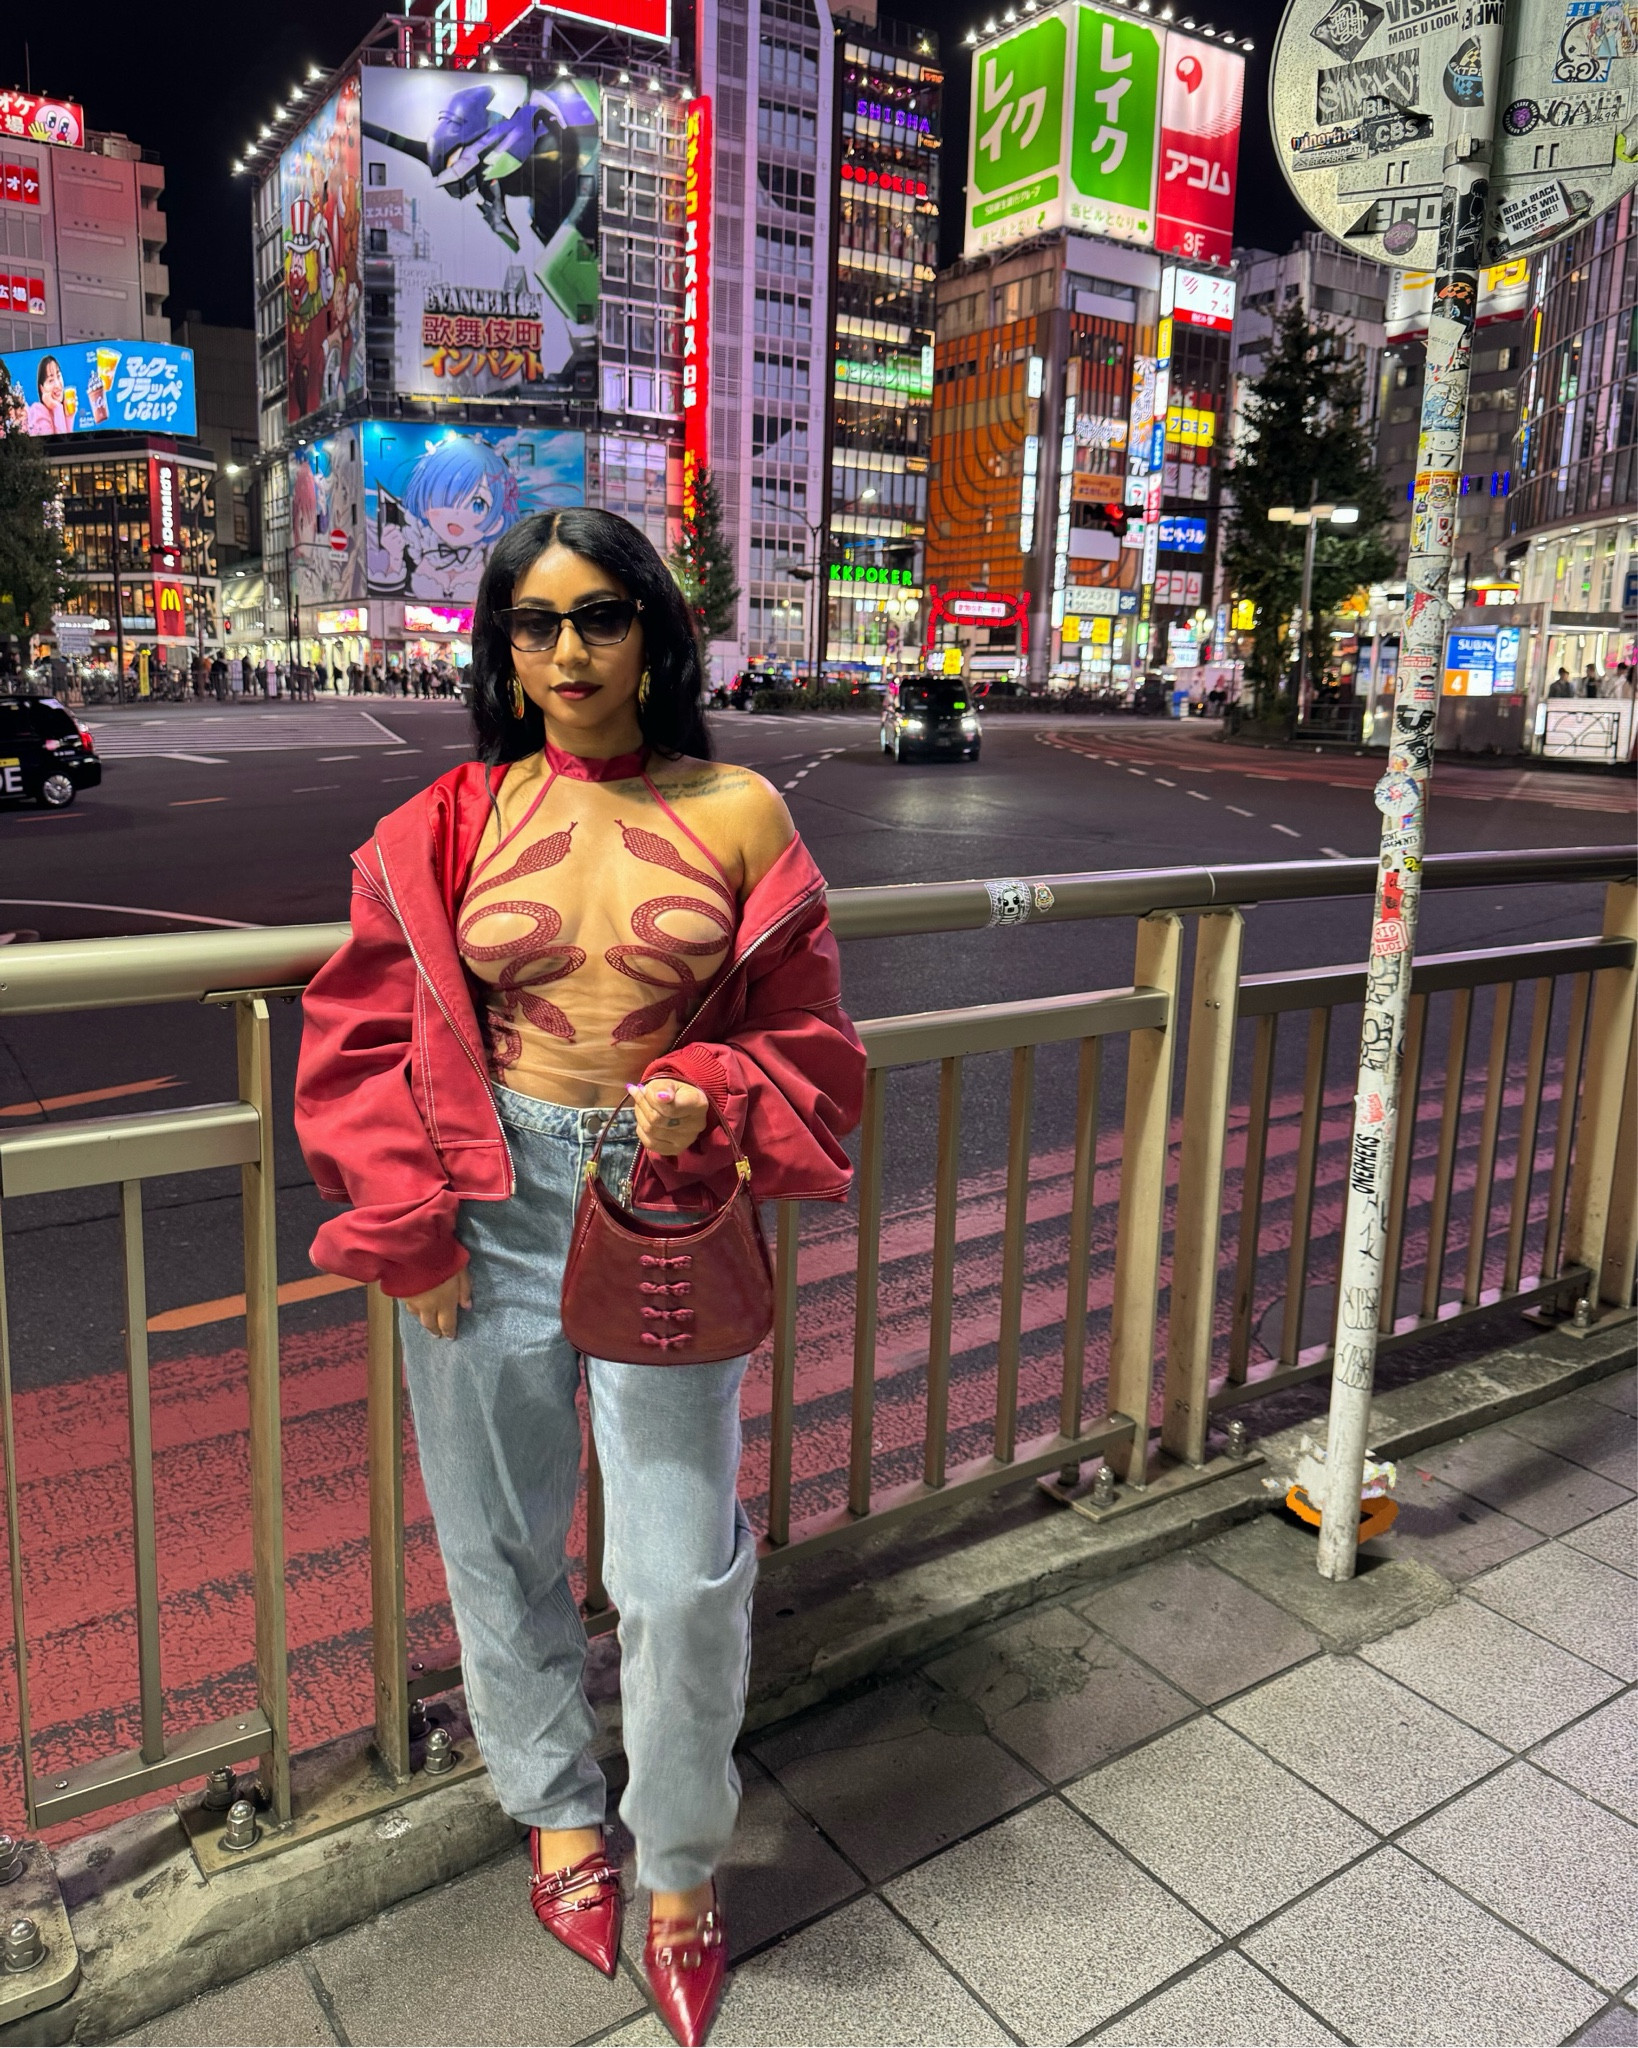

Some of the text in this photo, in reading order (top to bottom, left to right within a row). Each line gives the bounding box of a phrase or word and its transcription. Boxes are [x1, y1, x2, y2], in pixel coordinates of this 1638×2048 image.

[1388, 24, 1418, 45] MADE
[1421, 22, 1429, 34] U
[1431, 11, 1460, 31] LOOK
[979, 58, 1047, 162] レイク
[1091, 23, 1132, 174] レイク
[856, 98, 931, 133] SHISHA
[1376, 119, 1419, 143] CBS
[1165, 149, 1230, 195] アコム
[1503, 184, 1556, 215] RED & BLACK
[1504, 203, 1538, 225] STRIPES
[1540, 193, 1560, 208] WILL
[1512, 214, 1538, 232] NEVER
[1539, 204, 1559, 218] DIE!!
[1184, 231, 1205, 254] 3F
[423, 314, 544, 351] 歌舞伎町
[126, 356, 178, 379] マックで
[422, 346, 544, 381] インパクト
[116, 378, 183, 402] フラッペ
[1130, 456, 1150, 476] 7F
[1424, 453, 1455, 468] 17
[830, 564, 912, 585] KKPOKER
[1155, 576, 1199, 594] アコム
[1450, 675, 1462, 692] 4
